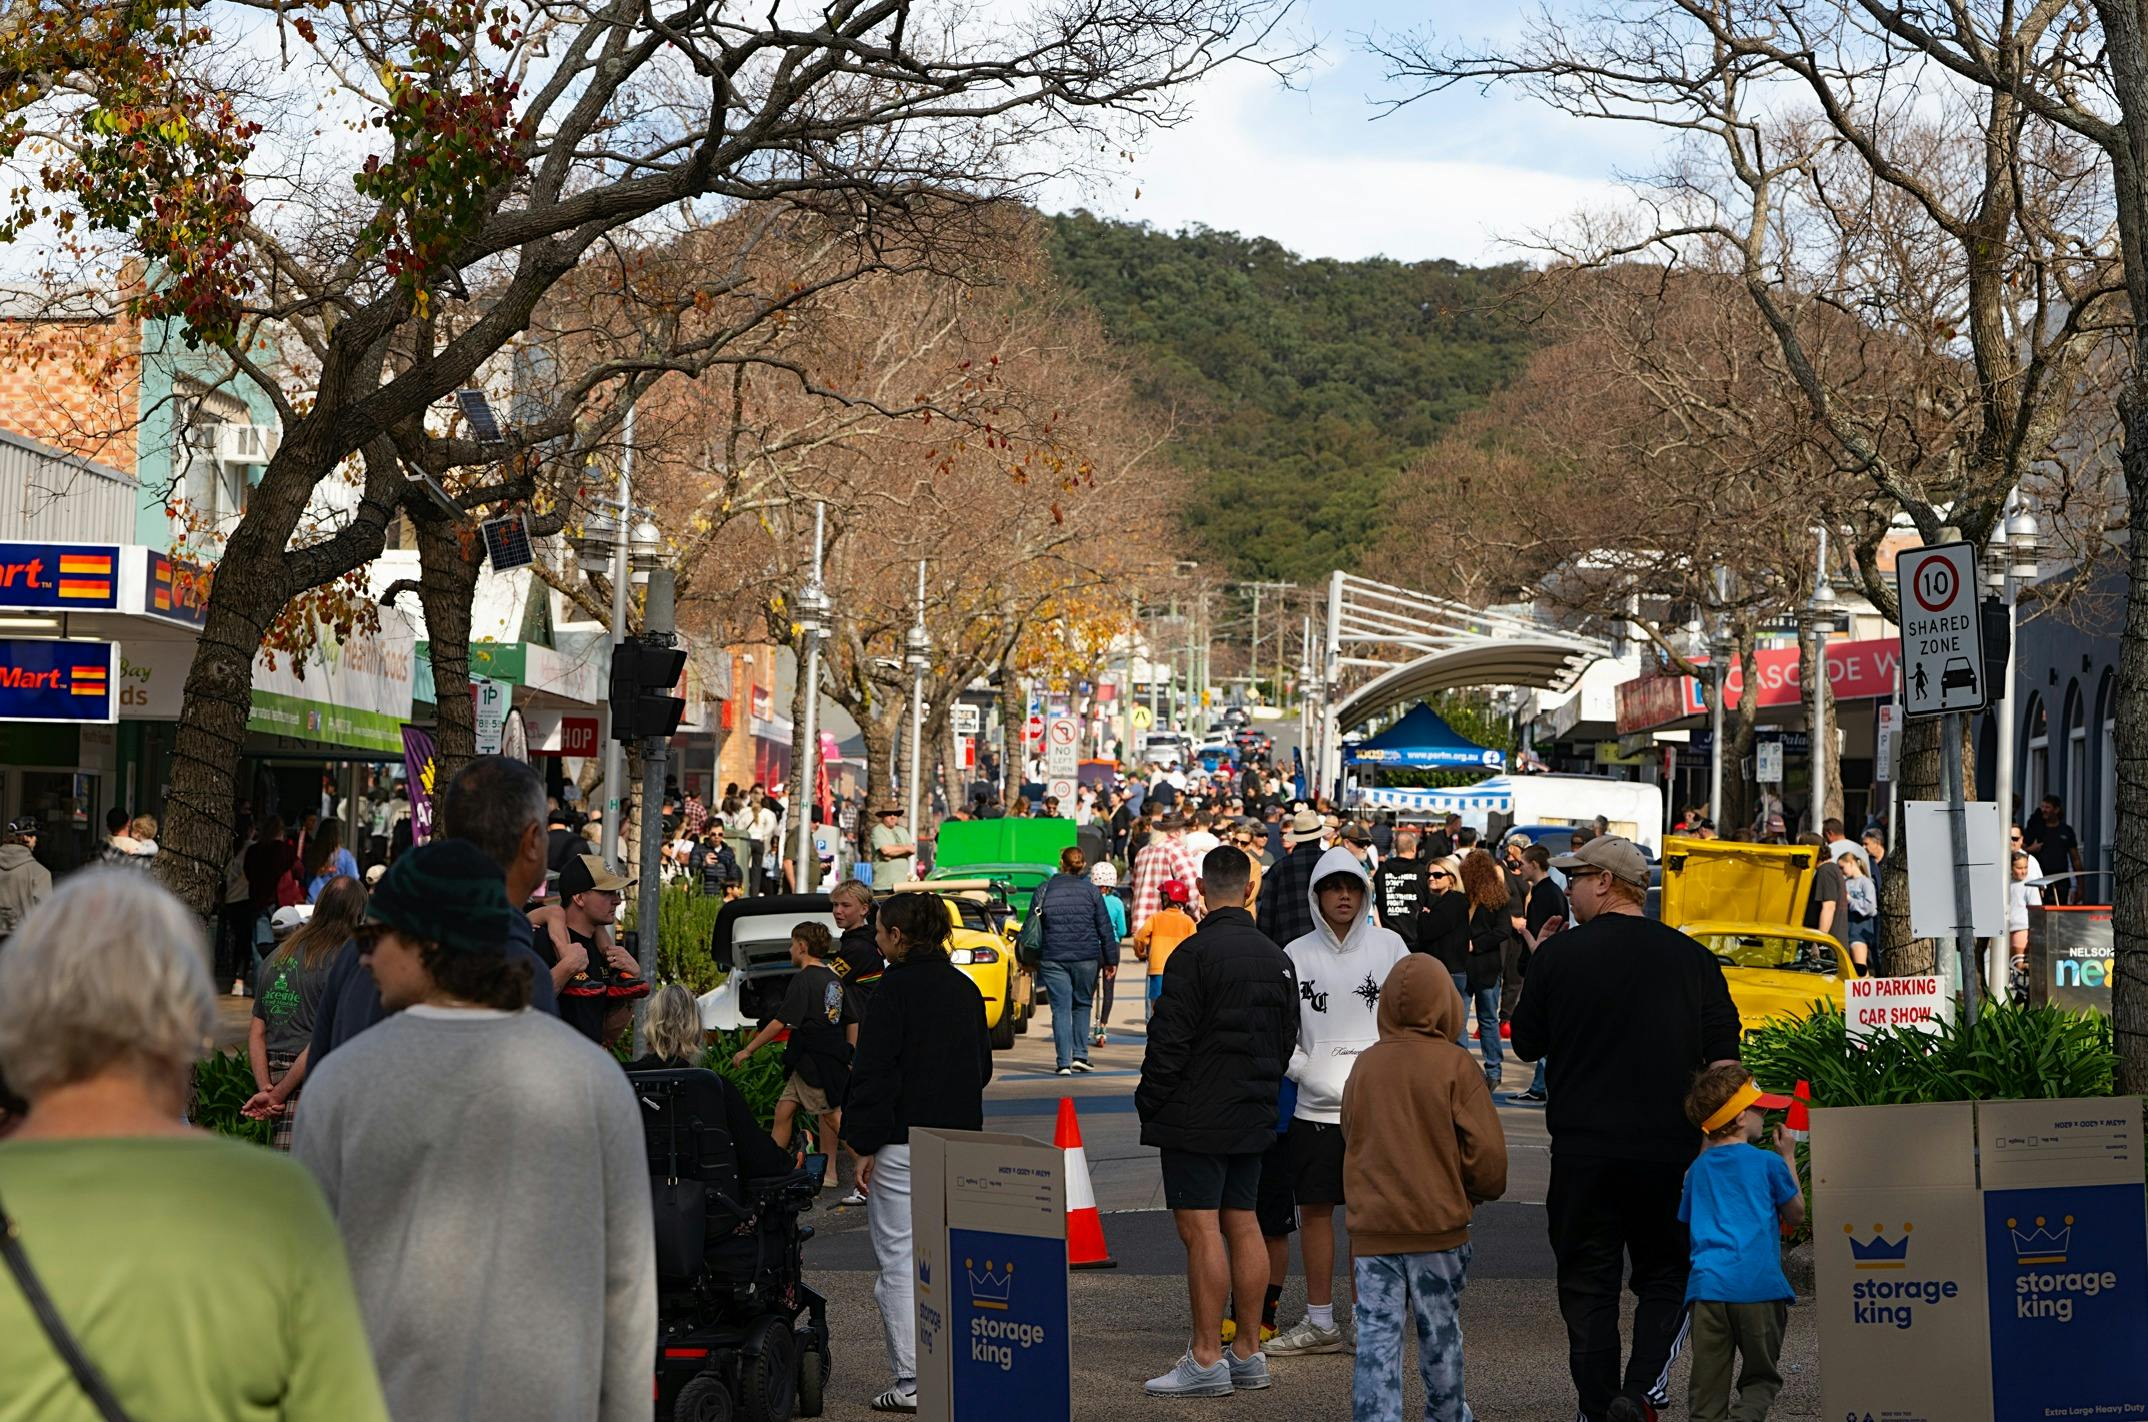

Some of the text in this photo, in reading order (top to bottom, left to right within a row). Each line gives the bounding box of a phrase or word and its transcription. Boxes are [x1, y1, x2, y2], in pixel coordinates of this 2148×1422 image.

[0, 558, 44, 589] rt
[1924, 571, 1948, 597] 10
[1909, 614, 1970, 637] SHARED
[1920, 636, 1960, 655] ZONE
[0, 666, 62, 689] Mart
[1725, 657, 1863, 693] CASCDE
[1055, 747, 1071, 755] NO
[2069, 947, 2114, 957] NELSON
[1852, 979, 1937, 997] NO PARKING
[1859, 1007, 1931, 1025] CAR SHOW
[1853, 1279, 1958, 1304] storage
[2016, 1271, 2117, 1295] storage
[920, 1303, 941, 1333] storage
[1854, 1301, 1912, 1329] king
[2017, 1295, 2073, 1322] king
[971, 1315, 1044, 1348] storage
[972, 1337, 1012, 1371] king
[2044, 1402, 2145, 1417] Extra Large Heavy Duty
